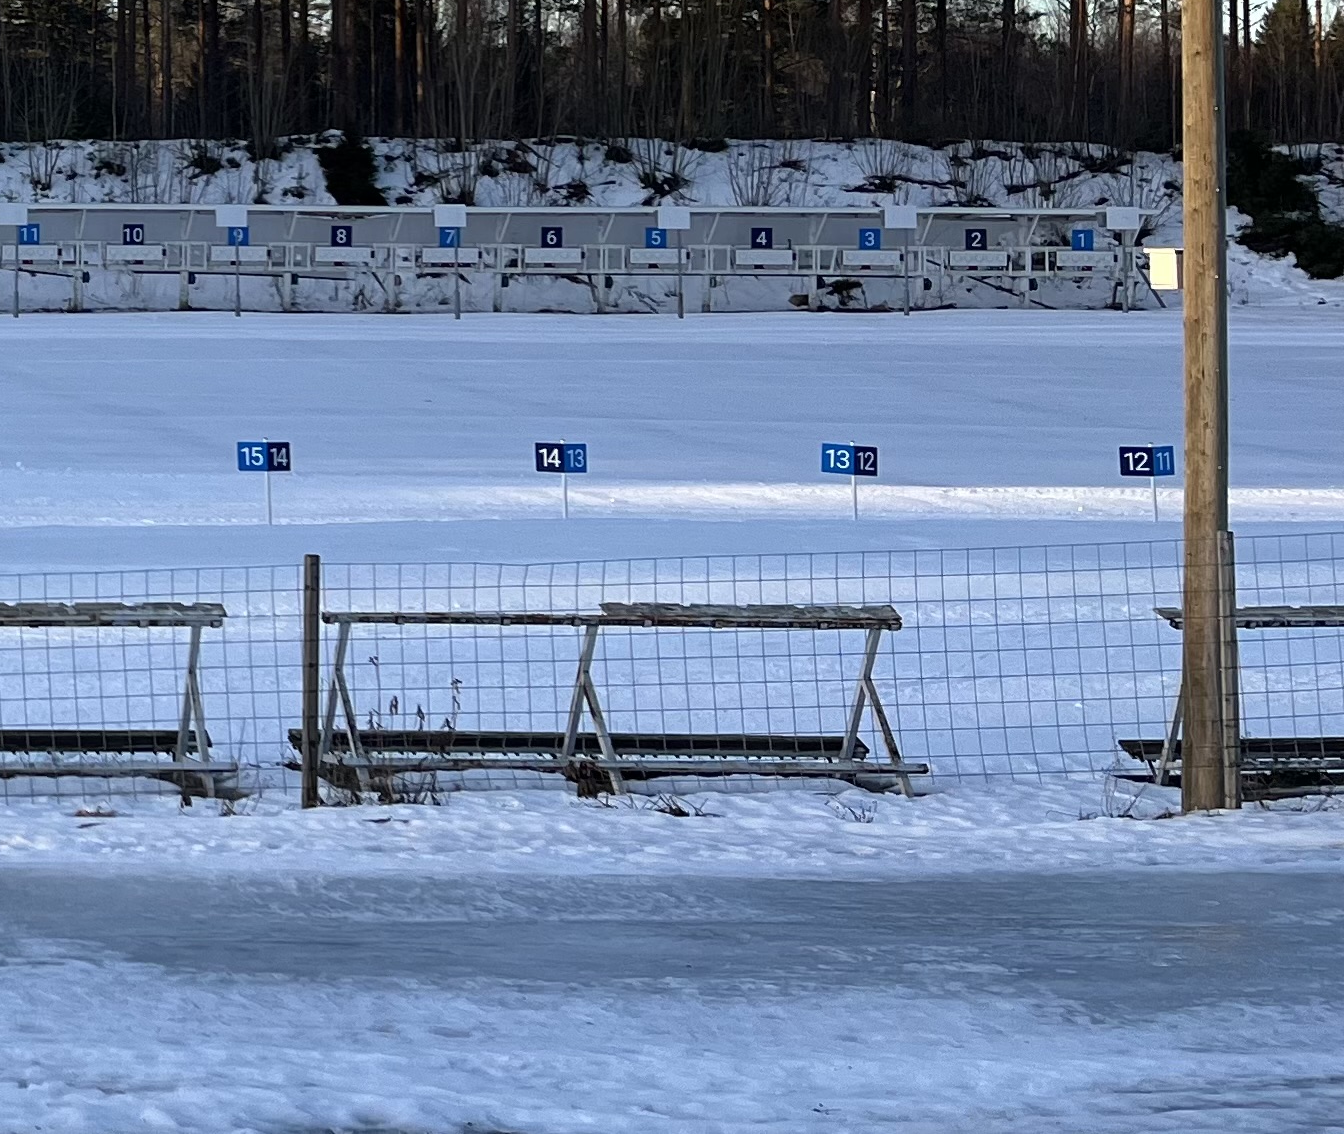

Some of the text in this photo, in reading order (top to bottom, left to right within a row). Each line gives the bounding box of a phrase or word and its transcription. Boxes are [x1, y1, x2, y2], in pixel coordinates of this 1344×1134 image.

[20, 227, 38, 242] 11
[123, 227, 143, 243] 10
[233, 228, 244, 242] 9
[336, 229, 347, 244] 8
[444, 229, 456, 244] 7
[546, 230, 557, 245] 6
[651, 230, 661, 245] 5
[756, 231, 767, 246] 4
[864, 231, 875, 246] 3
[971, 232, 982, 247] 2
[1077, 233, 1085, 248] 1
[240, 446, 264, 466] 15
[269, 447, 289, 467] 14
[538, 448, 561, 468] 14
[567, 448, 585, 468] 13
[825, 449, 850, 469] 13
[857, 451, 875, 471] 12
[1123, 451, 1150, 471] 12
[1155, 451, 1171, 471] 11
